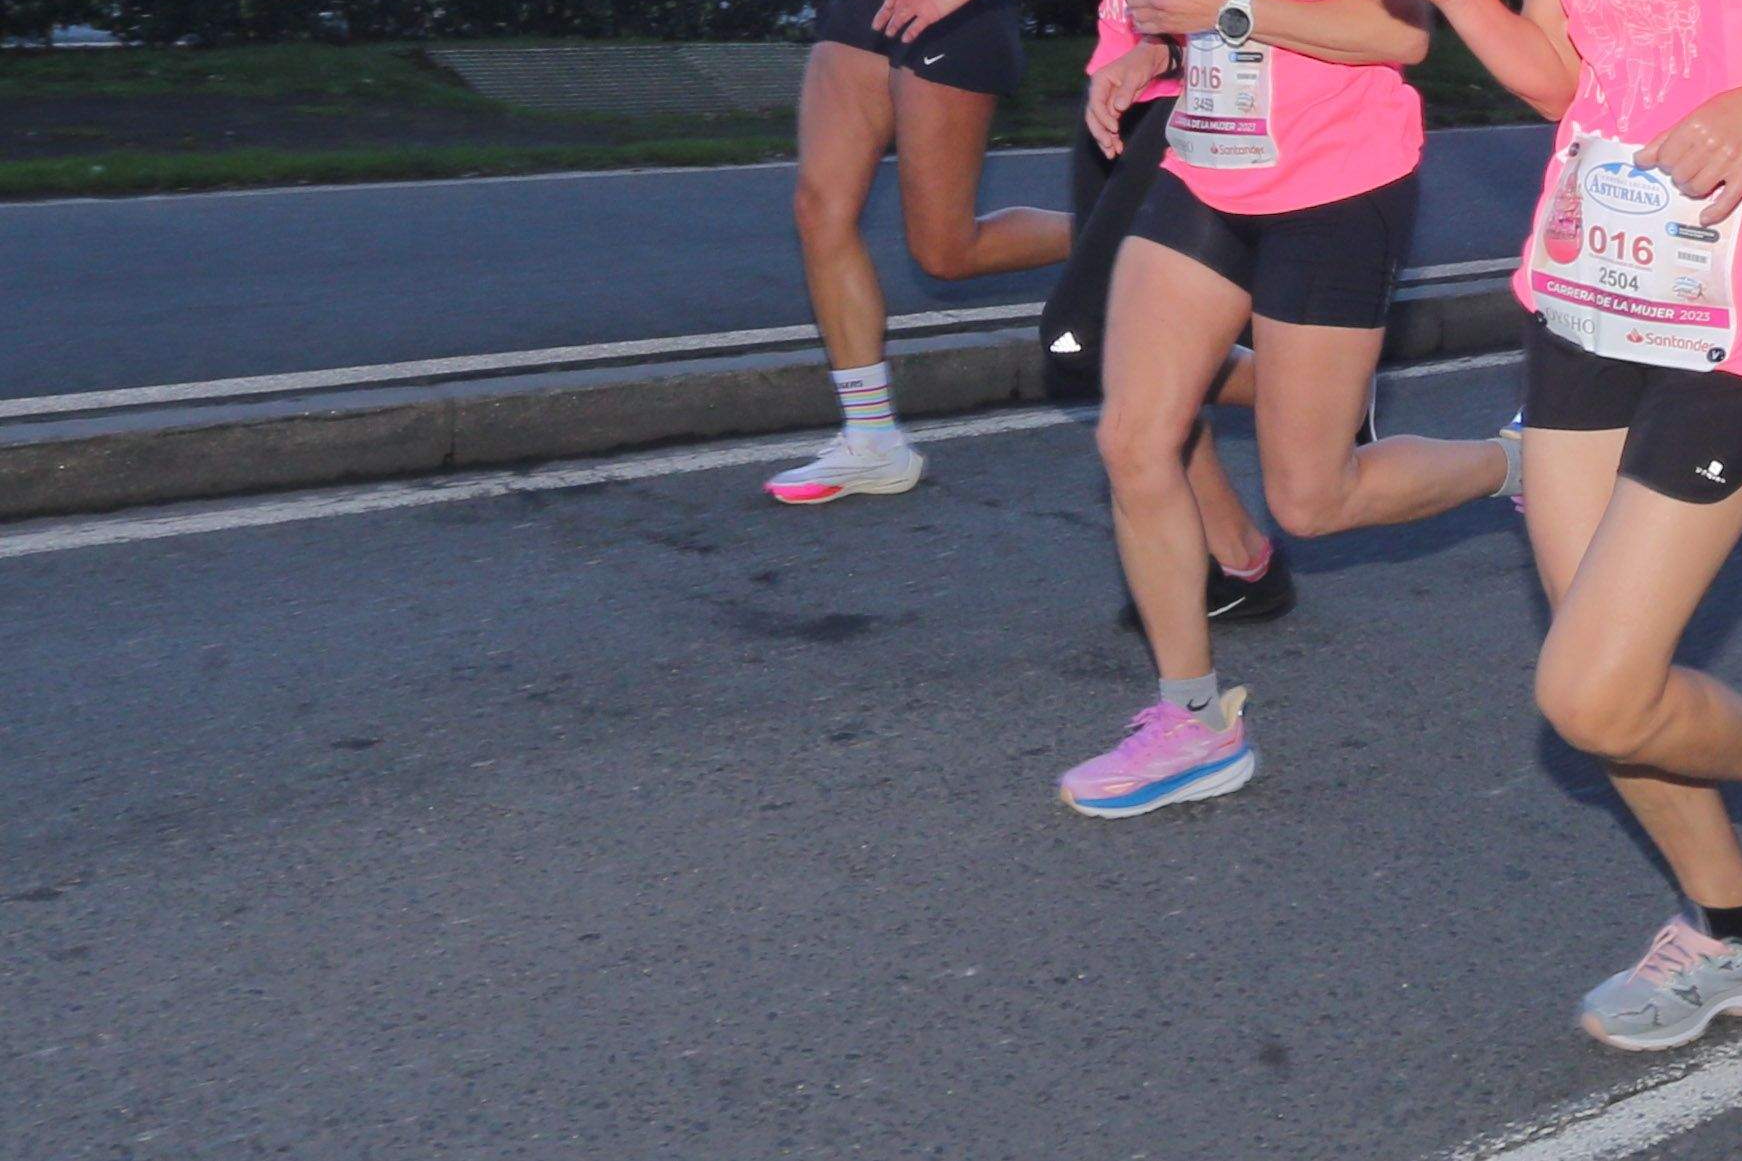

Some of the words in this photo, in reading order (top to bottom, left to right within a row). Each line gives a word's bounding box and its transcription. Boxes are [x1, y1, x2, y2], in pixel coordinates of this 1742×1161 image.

[1190, 66, 1221, 89] 016
[1589, 174, 1661, 207] ASTURIANA
[1589, 225, 1653, 265] 016
[1599, 267, 1639, 291] 2504
[1546, 280, 1596, 303] CARRERA
[1596, 294, 1612, 308] DE
[1612, 298, 1629, 313] LA
[1631, 303, 1675, 319] MUJER
[1680, 309, 1711, 322] 2023
